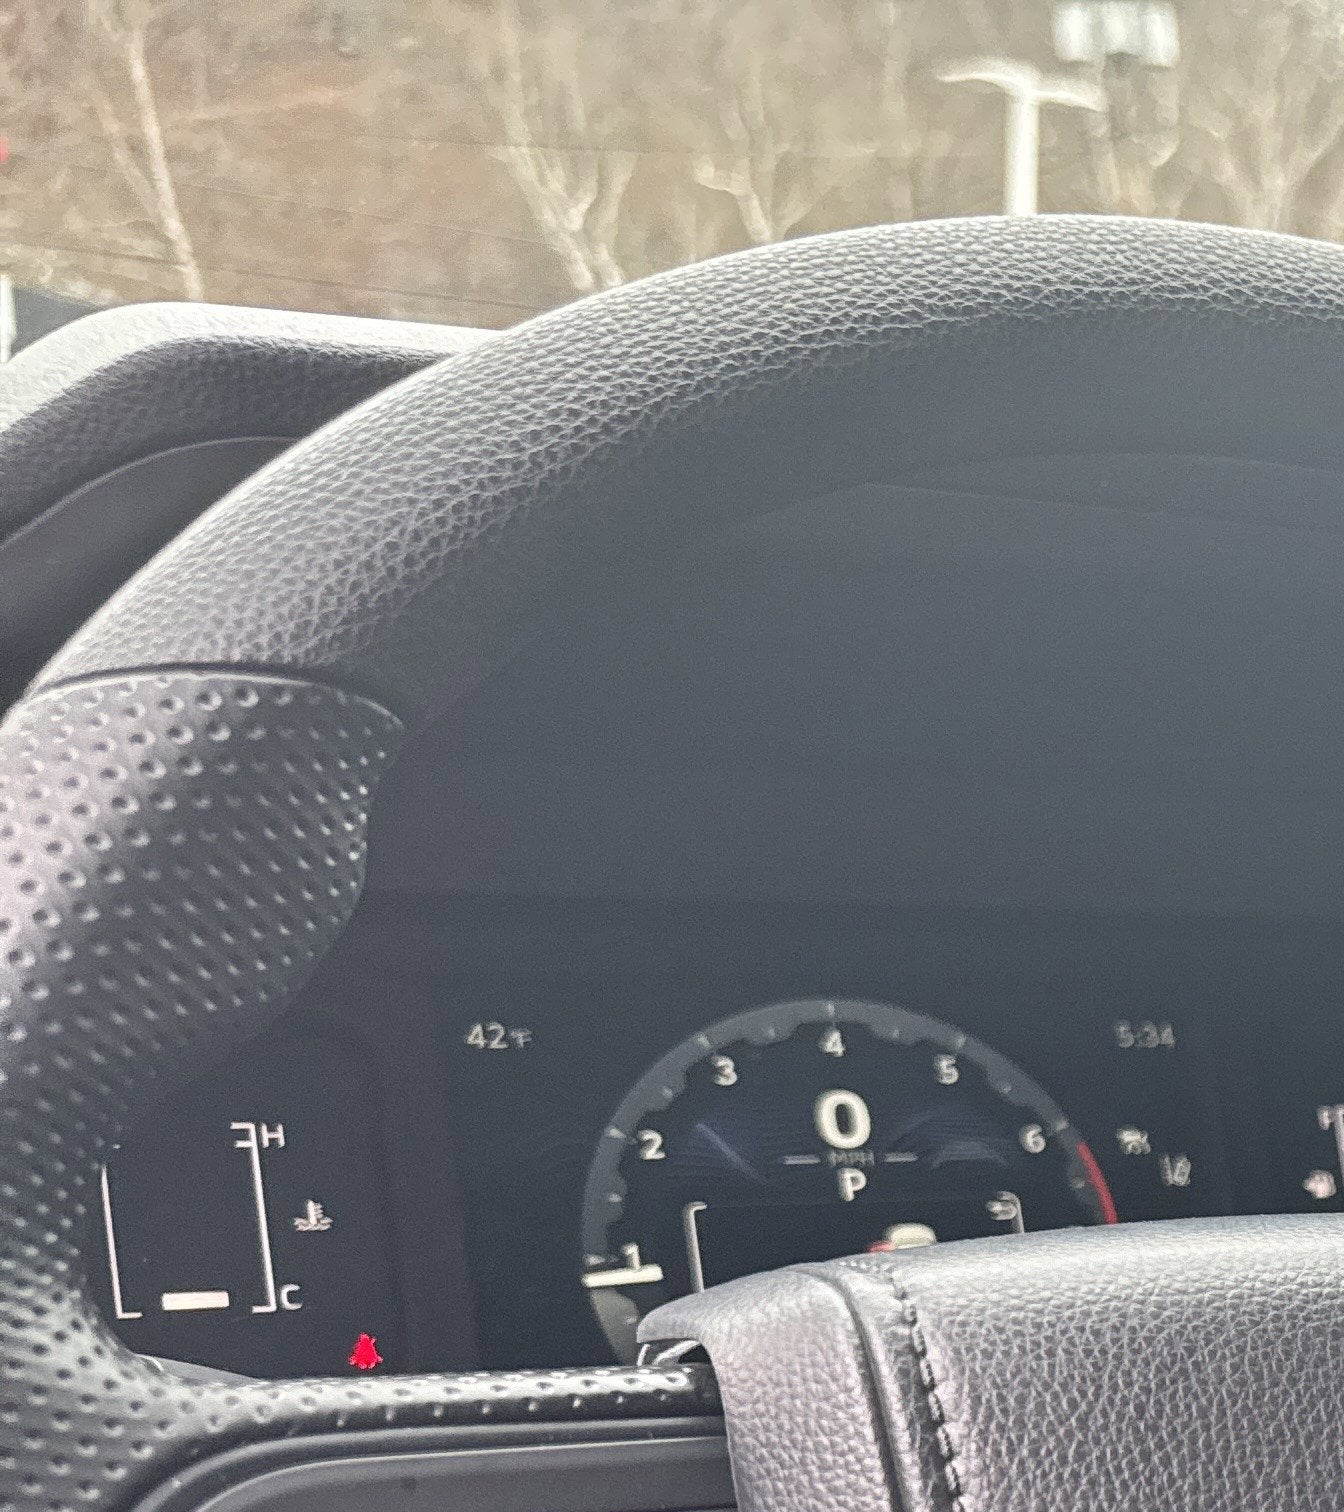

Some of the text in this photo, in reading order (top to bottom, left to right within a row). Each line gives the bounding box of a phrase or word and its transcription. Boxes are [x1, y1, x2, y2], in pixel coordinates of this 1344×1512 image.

[818, 1027, 846, 1057] 4
[711, 1054, 738, 1086] 3
[933, 1053, 960, 1085] 5
[814, 1089, 871, 1149] 0
[261, 1122, 286, 1149] H
[638, 1129, 666, 1160] 2
[1019, 1123, 1046, 1154] 6
[837, 1166, 867, 1202] P
[280, 1283, 303, 1311] C
